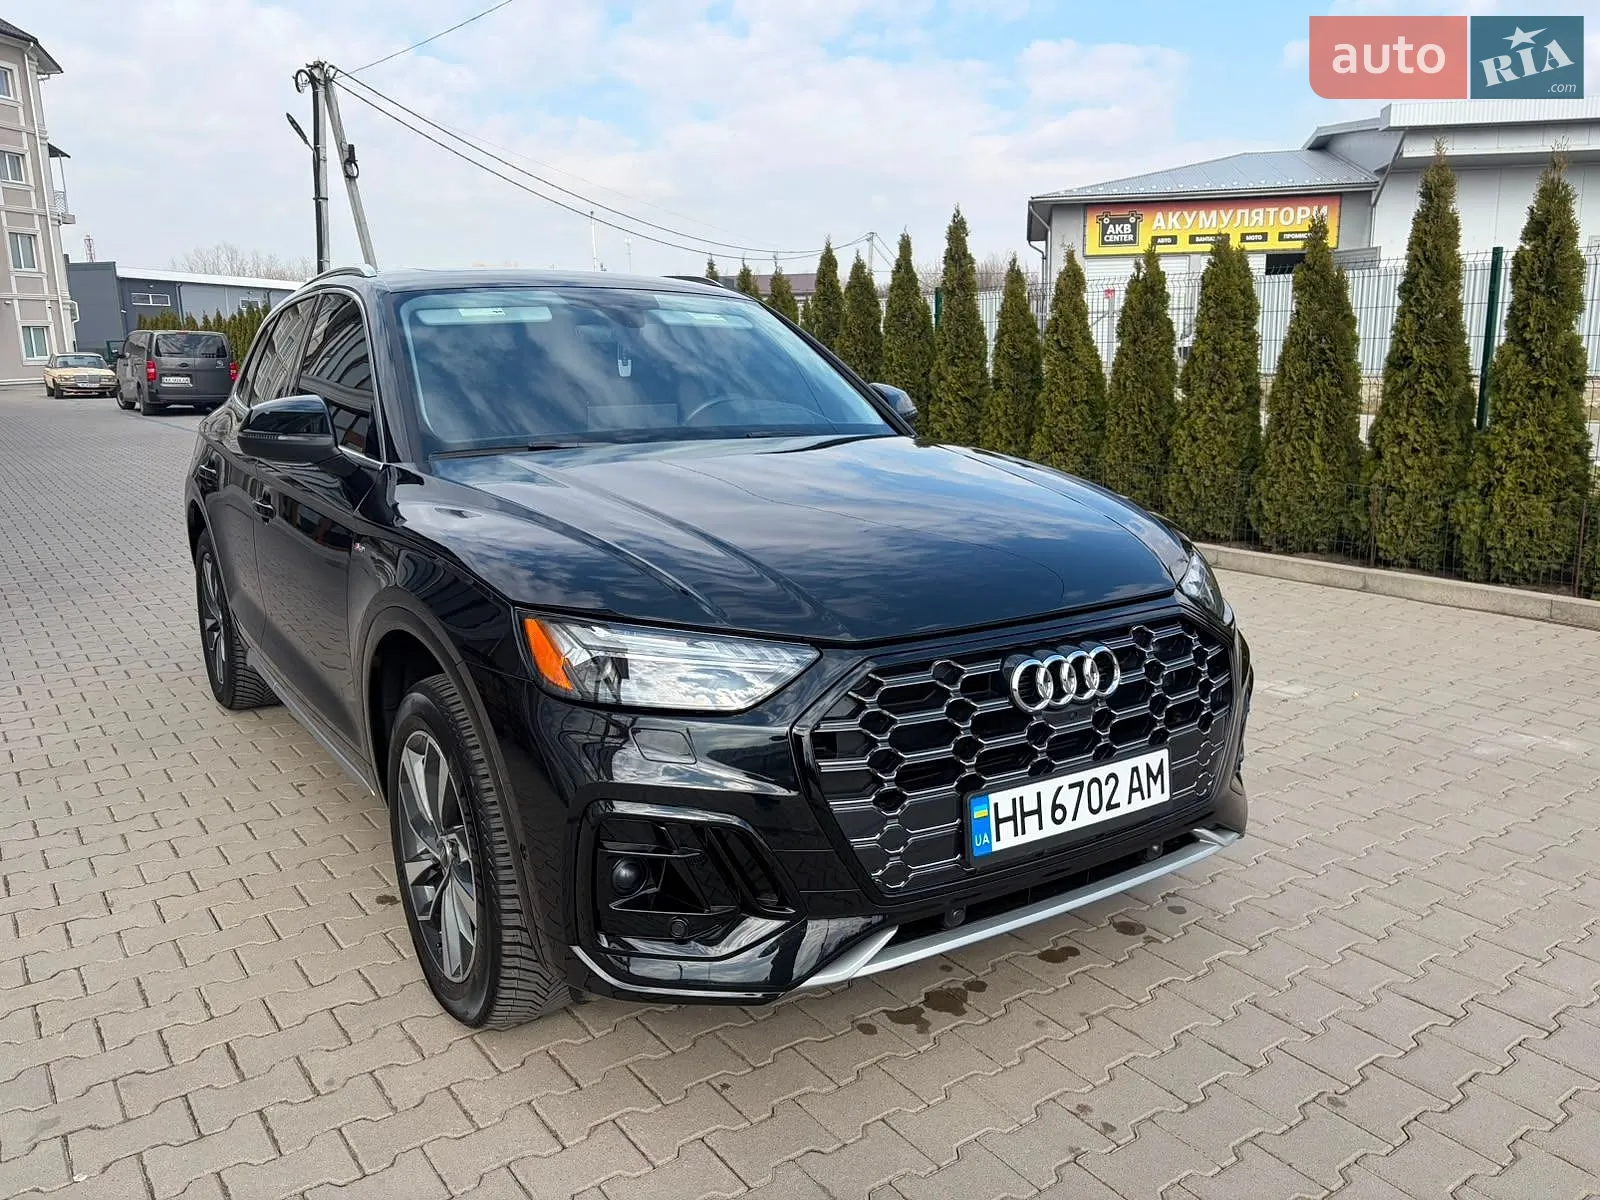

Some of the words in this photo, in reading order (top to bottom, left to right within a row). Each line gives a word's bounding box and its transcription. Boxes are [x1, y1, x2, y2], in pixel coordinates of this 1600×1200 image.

[1106, 223, 1132, 234] AKB
[1104, 234, 1134, 242] CENTER
[994, 791, 1043, 842] HH
[1050, 772, 1121, 826] 6702
[1127, 758, 1165, 805] AM
[975, 834, 990, 846] UA
